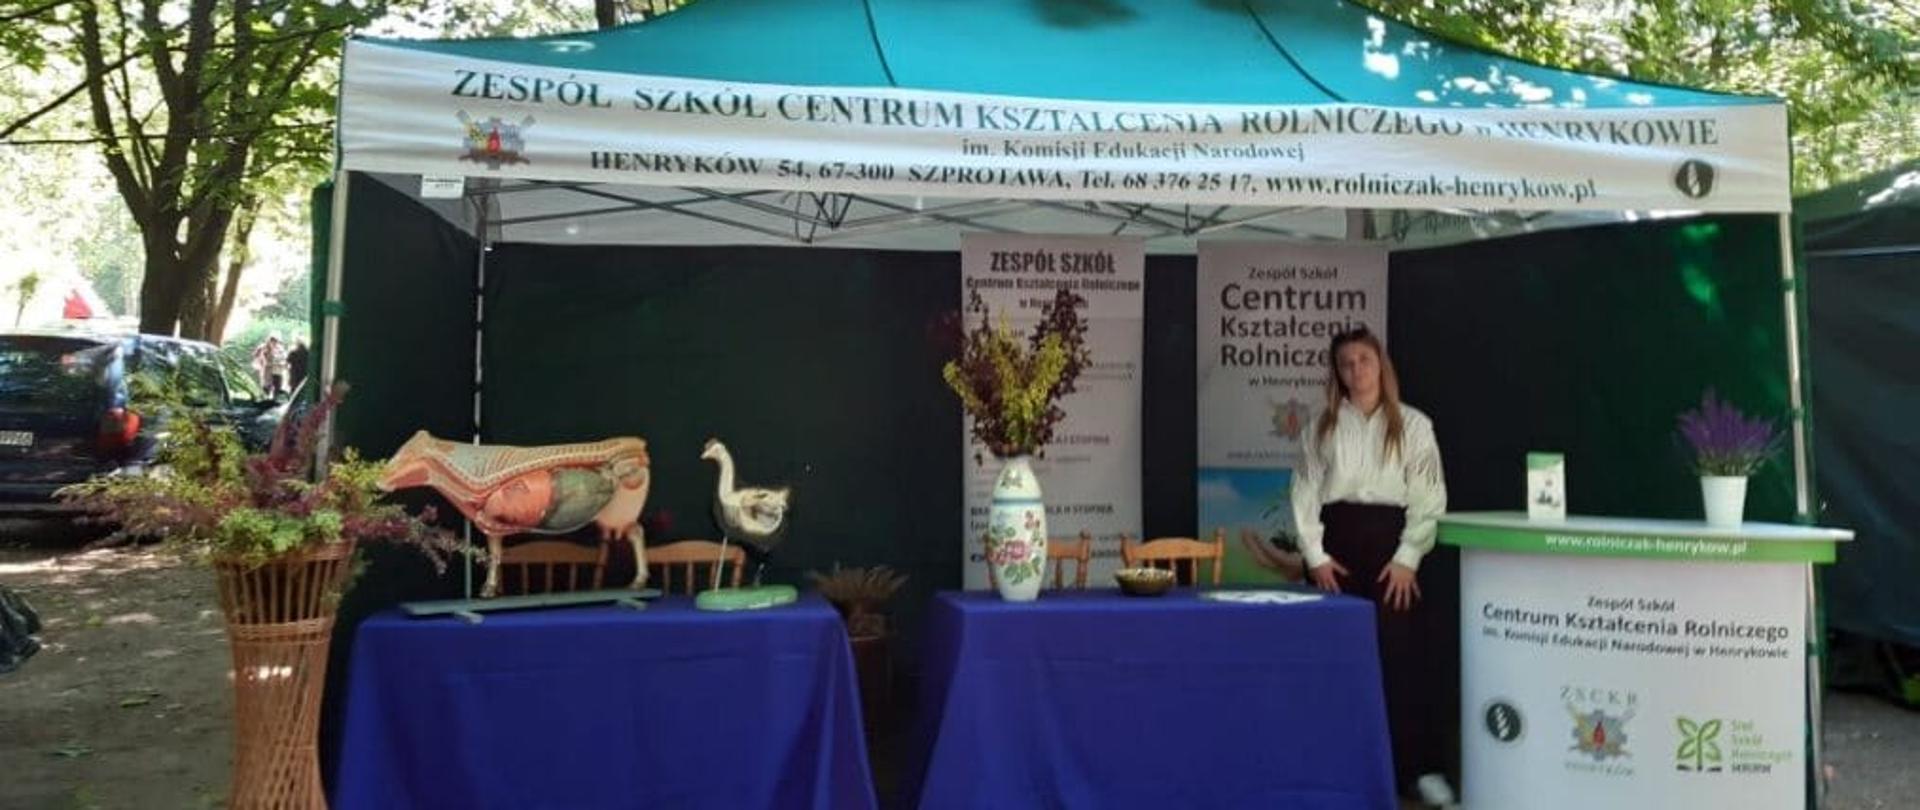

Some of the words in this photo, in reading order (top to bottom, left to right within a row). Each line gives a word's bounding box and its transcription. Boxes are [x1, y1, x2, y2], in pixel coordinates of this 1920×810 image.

[777, 92, 963, 128] CENTRUM
[1004, 139, 1086, 159] Komisji
[1093, 140, 1186, 161] Edukacji
[1193, 142, 1305, 163] Narodowej
[591, 150, 765, 174] HENRYKÓW
[777, 159, 812, 180] 54,
[818, 162, 895, 180] 67-300
[1081, 170, 1115, 189] Tel.
[1123, 172, 1148, 189] 68
[1153, 173, 1191, 190] 376
[1198, 173, 1221, 190] 25
[1266, 172, 1598, 203] www.rolniczak-henrykow.pl
[990, 249, 1056, 273] ZESPÓŁ
[1061, 249, 1116, 274] SZKÓŁ
[1249, 266, 1297, 281] Zespół
[1301, 266, 1339, 280] Szkół
[1220, 283, 1366, 311] Centrum
[1220, 343, 1332, 367] Rolnicze
[1483, 602, 1560, 627] Centrum
[1566, 612, 1679, 635] Kształcenia
[1685, 619, 1789, 643] Rolniczego
